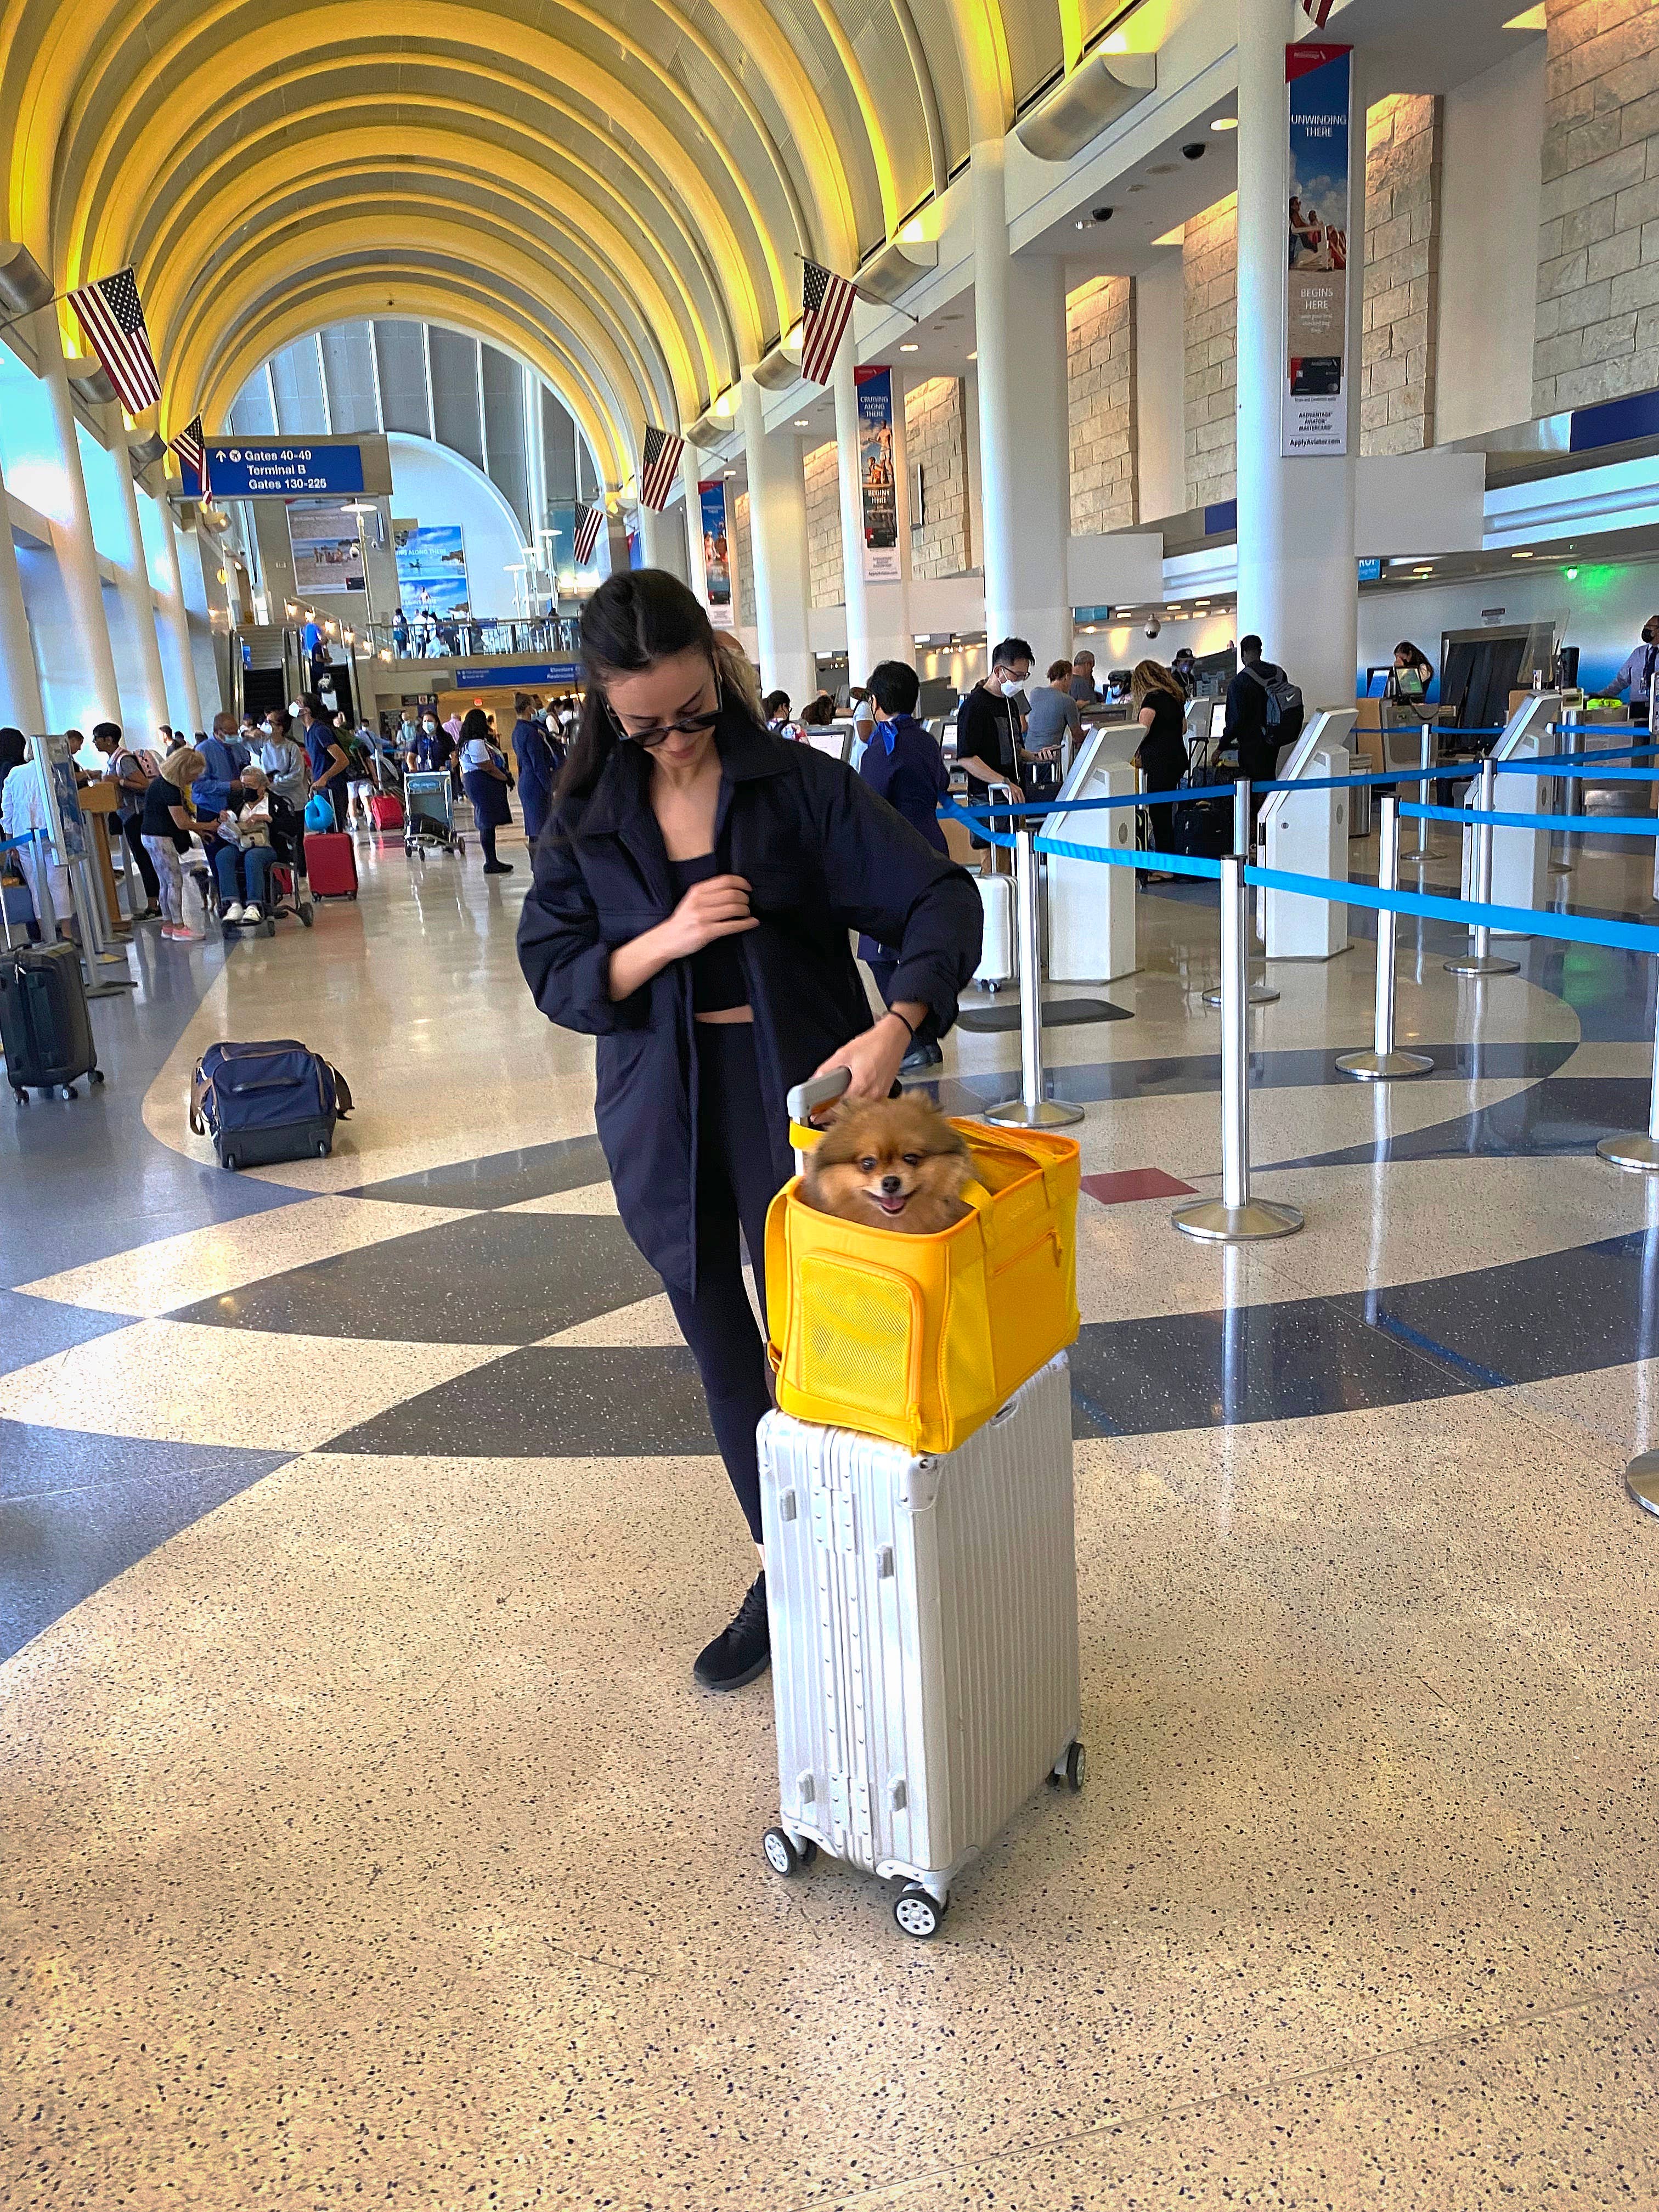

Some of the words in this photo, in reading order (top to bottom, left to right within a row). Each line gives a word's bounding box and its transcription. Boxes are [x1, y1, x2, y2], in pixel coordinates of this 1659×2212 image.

[1291, 114, 1347, 125] UNWINDING
[1305, 126, 1333, 137] THERE
[1301, 287, 1333, 297] BEGINS
[1306, 300, 1328, 309] HERE
[1290, 438, 1340, 447] ApplyAviator.com
[245, 450, 278, 461] Gates
[280, 450, 312, 461] 40-49
[247, 464, 295, 475] Terminal
[297, 464, 306, 475] B
[249, 479, 281, 490] Gates
[285, 478, 327, 489] 130-225
